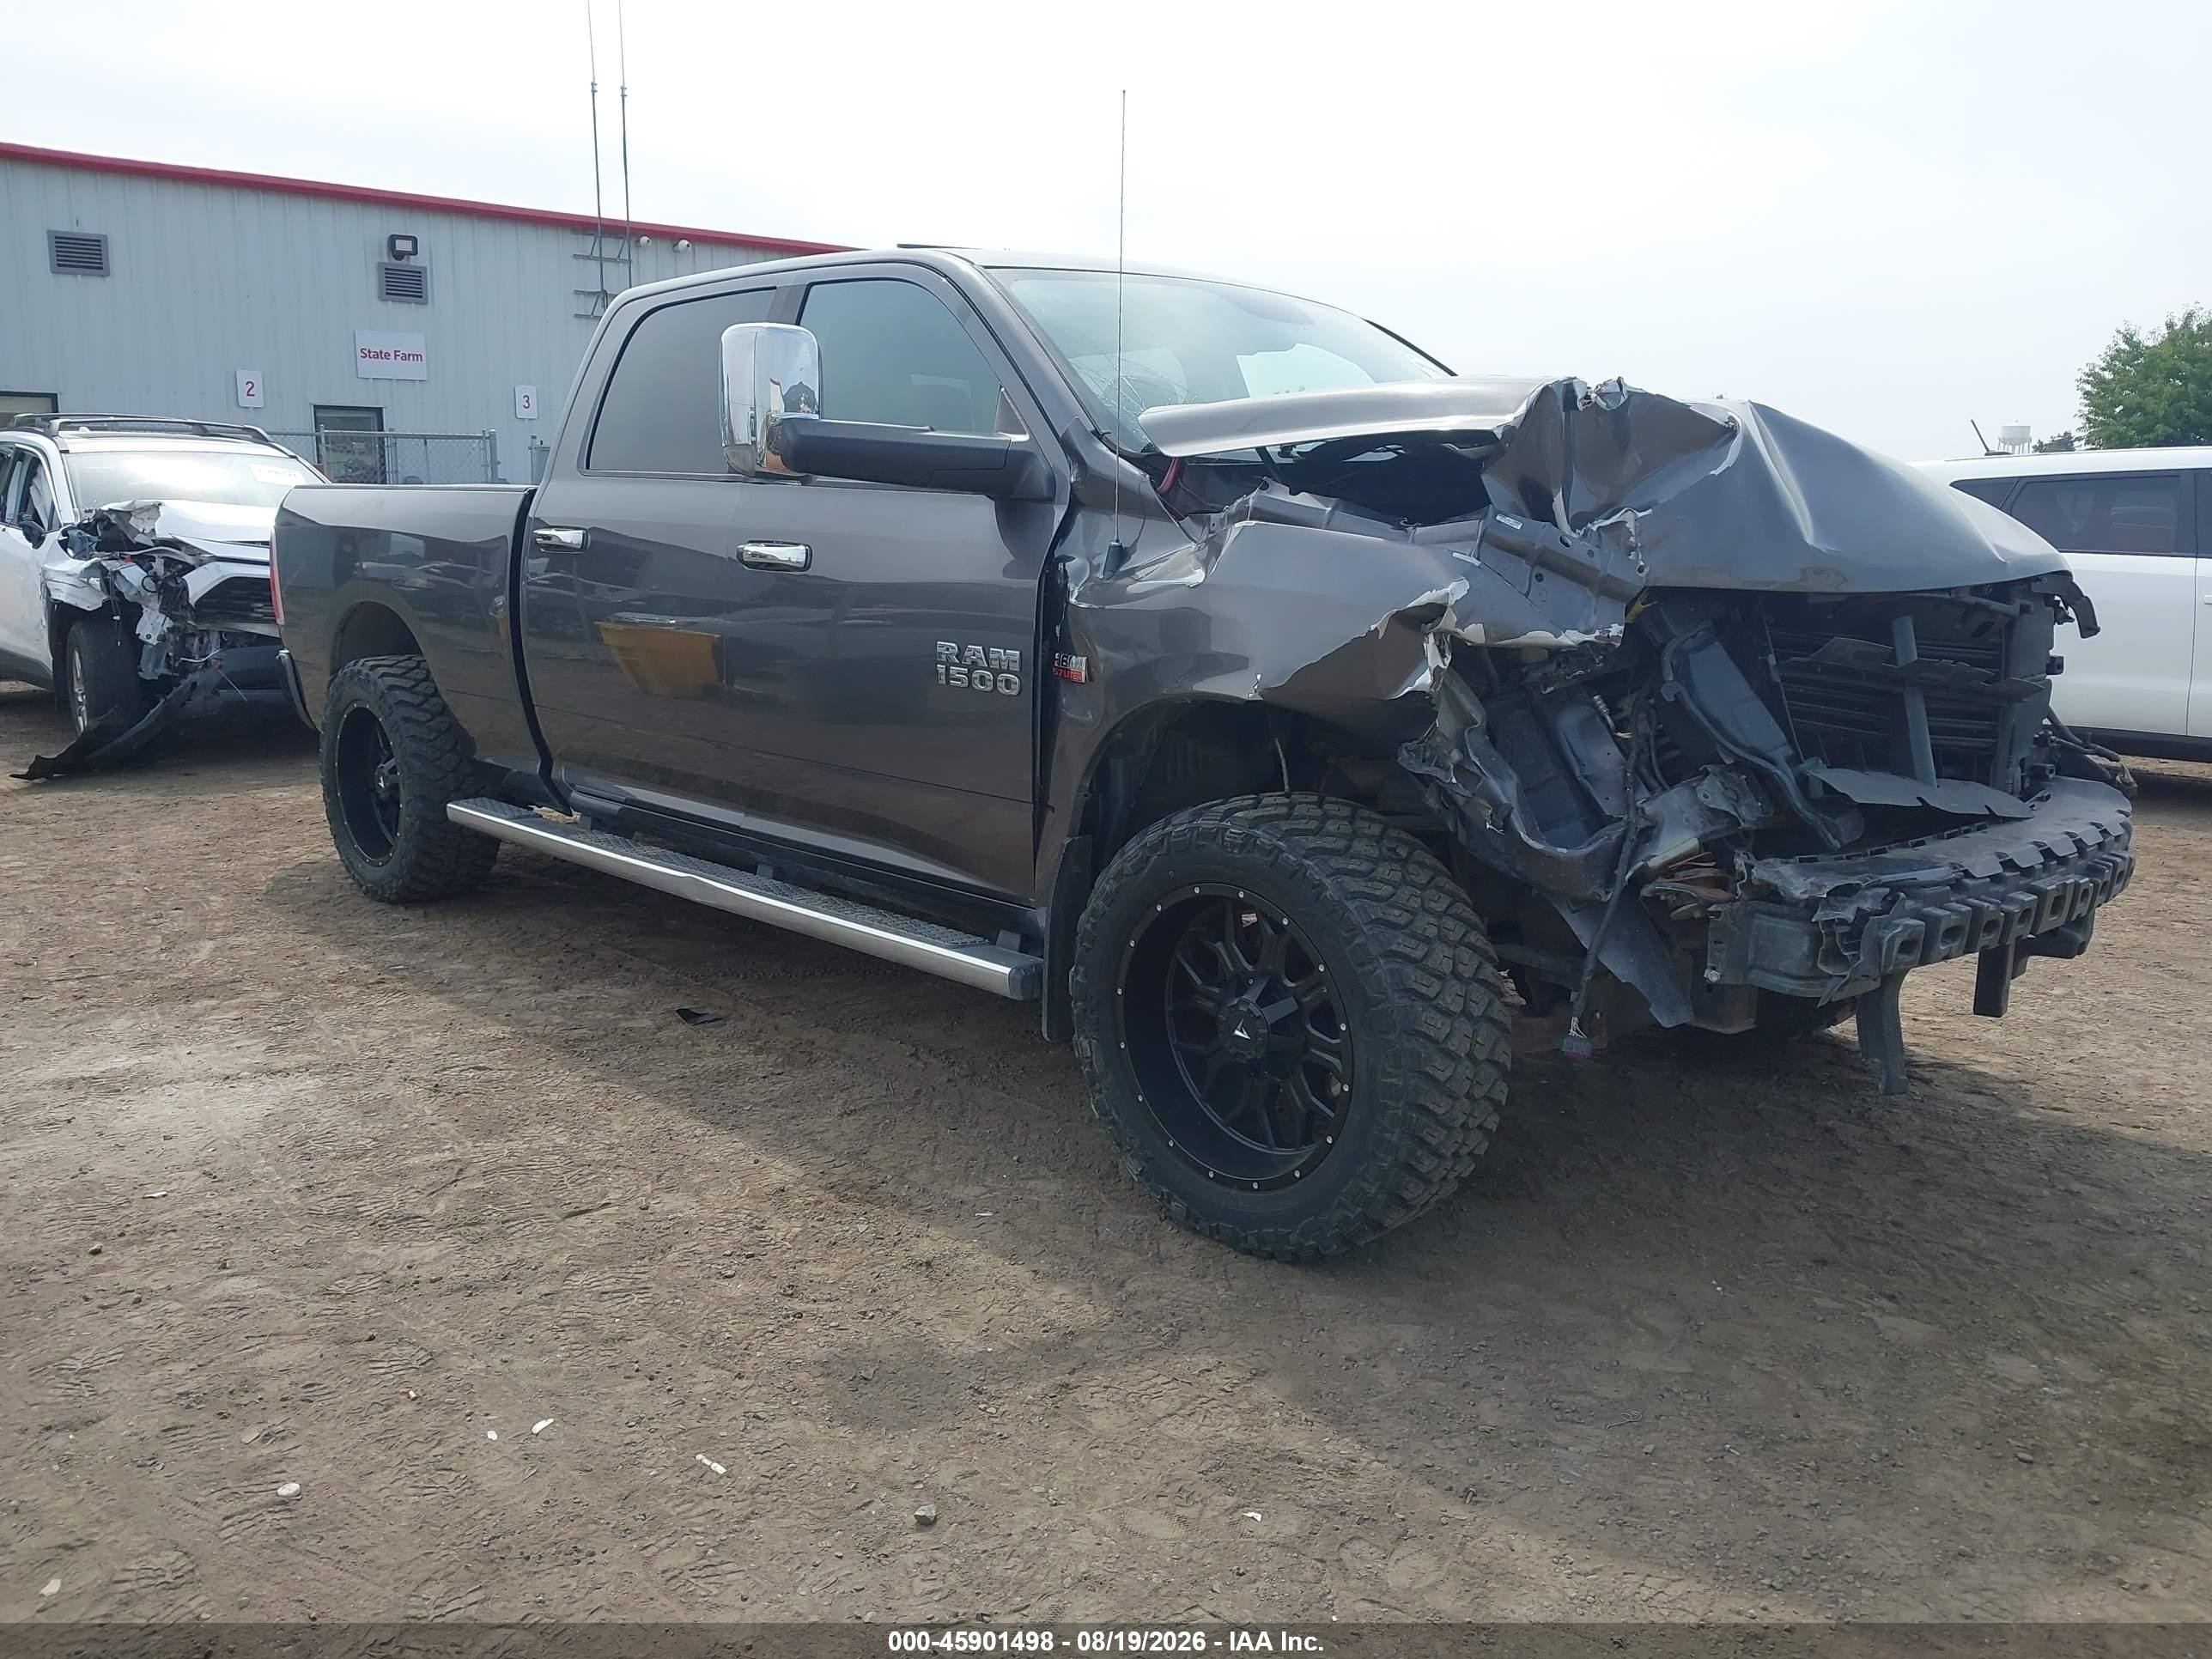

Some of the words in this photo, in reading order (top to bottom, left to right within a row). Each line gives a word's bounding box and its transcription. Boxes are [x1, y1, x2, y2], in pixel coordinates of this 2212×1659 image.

[360, 348, 391, 360] State
[393, 349, 423, 362] Farm
[246, 380, 255, 397] 2
[523, 394, 531, 410] 3
[936, 641, 1020, 672] RAM
[936, 664, 1021, 696] 1500
